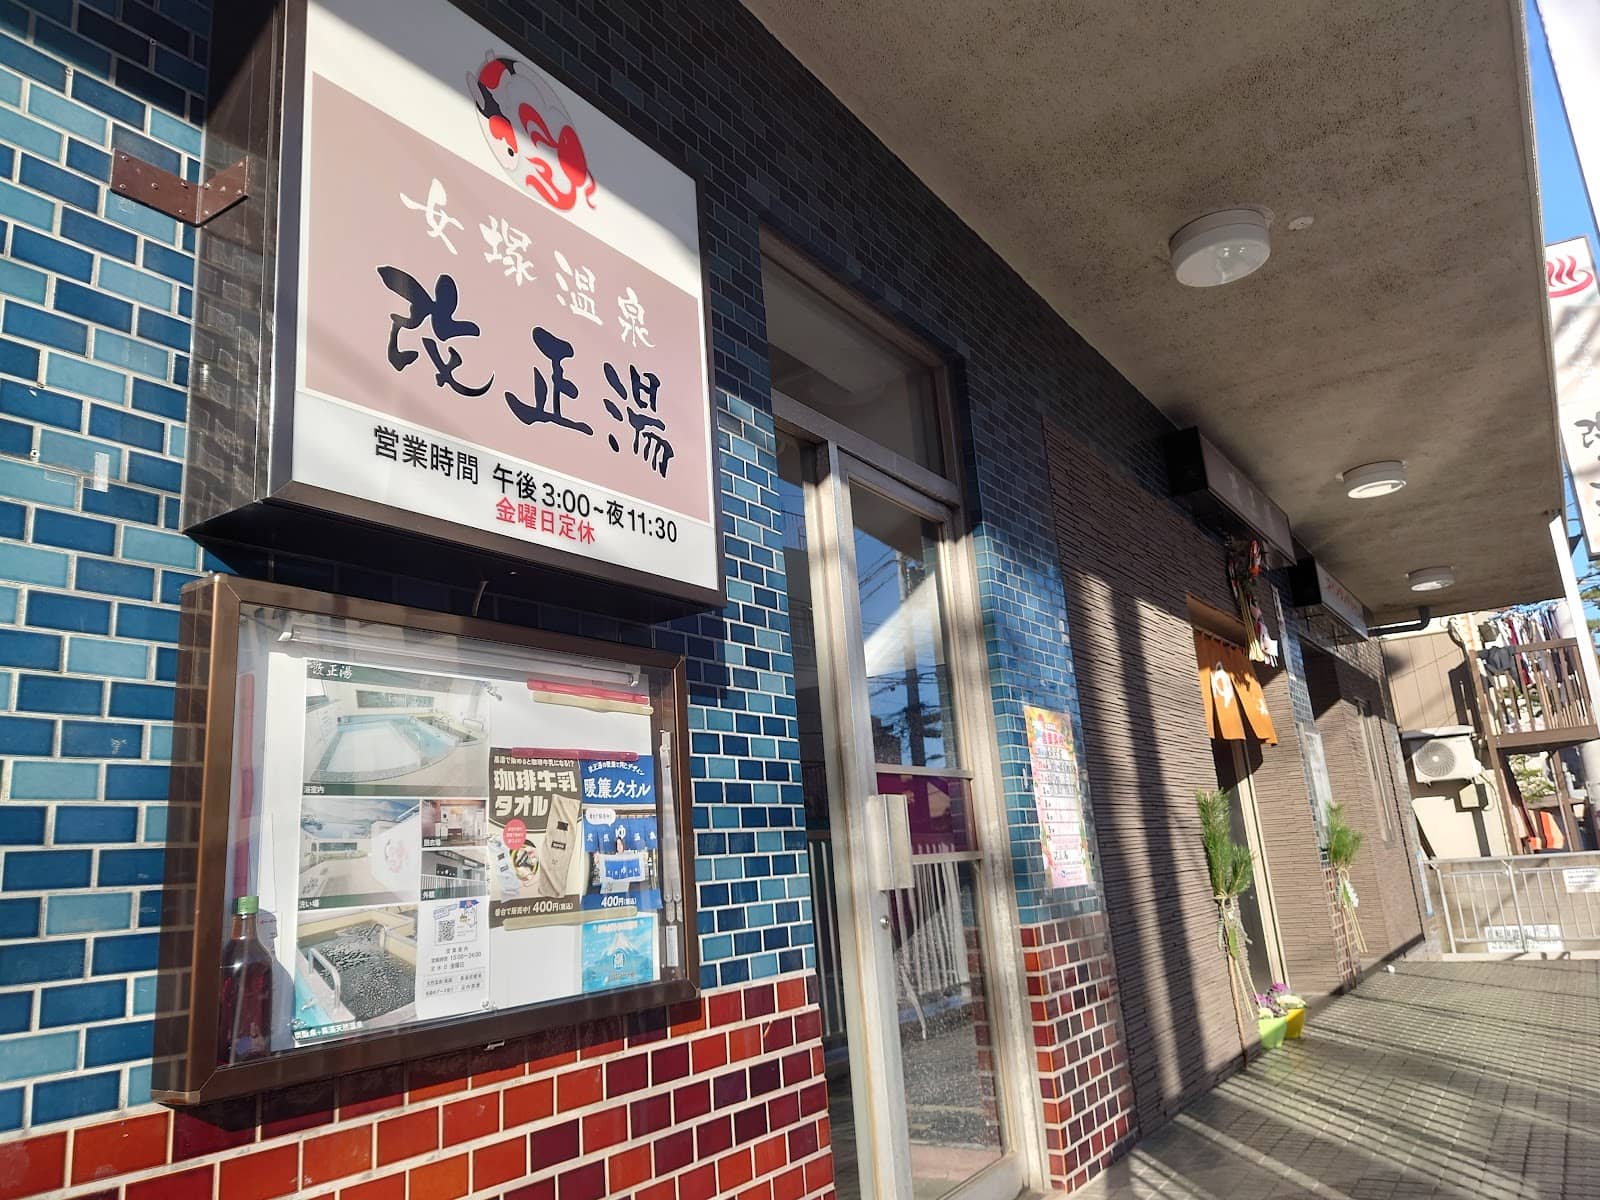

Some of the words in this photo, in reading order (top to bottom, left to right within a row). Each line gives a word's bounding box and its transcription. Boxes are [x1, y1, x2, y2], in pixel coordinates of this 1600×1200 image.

[400, 178, 655, 348] 女塚温泉
[377, 265, 675, 478] 改正湯
[374, 425, 479, 485] 営業時間
[495, 496, 596, 545] 金曜日定休
[493, 768, 578, 792] 珈琲牛乳
[583, 777, 651, 799] 暖簾タオル
[495, 795, 549, 817] タオル
